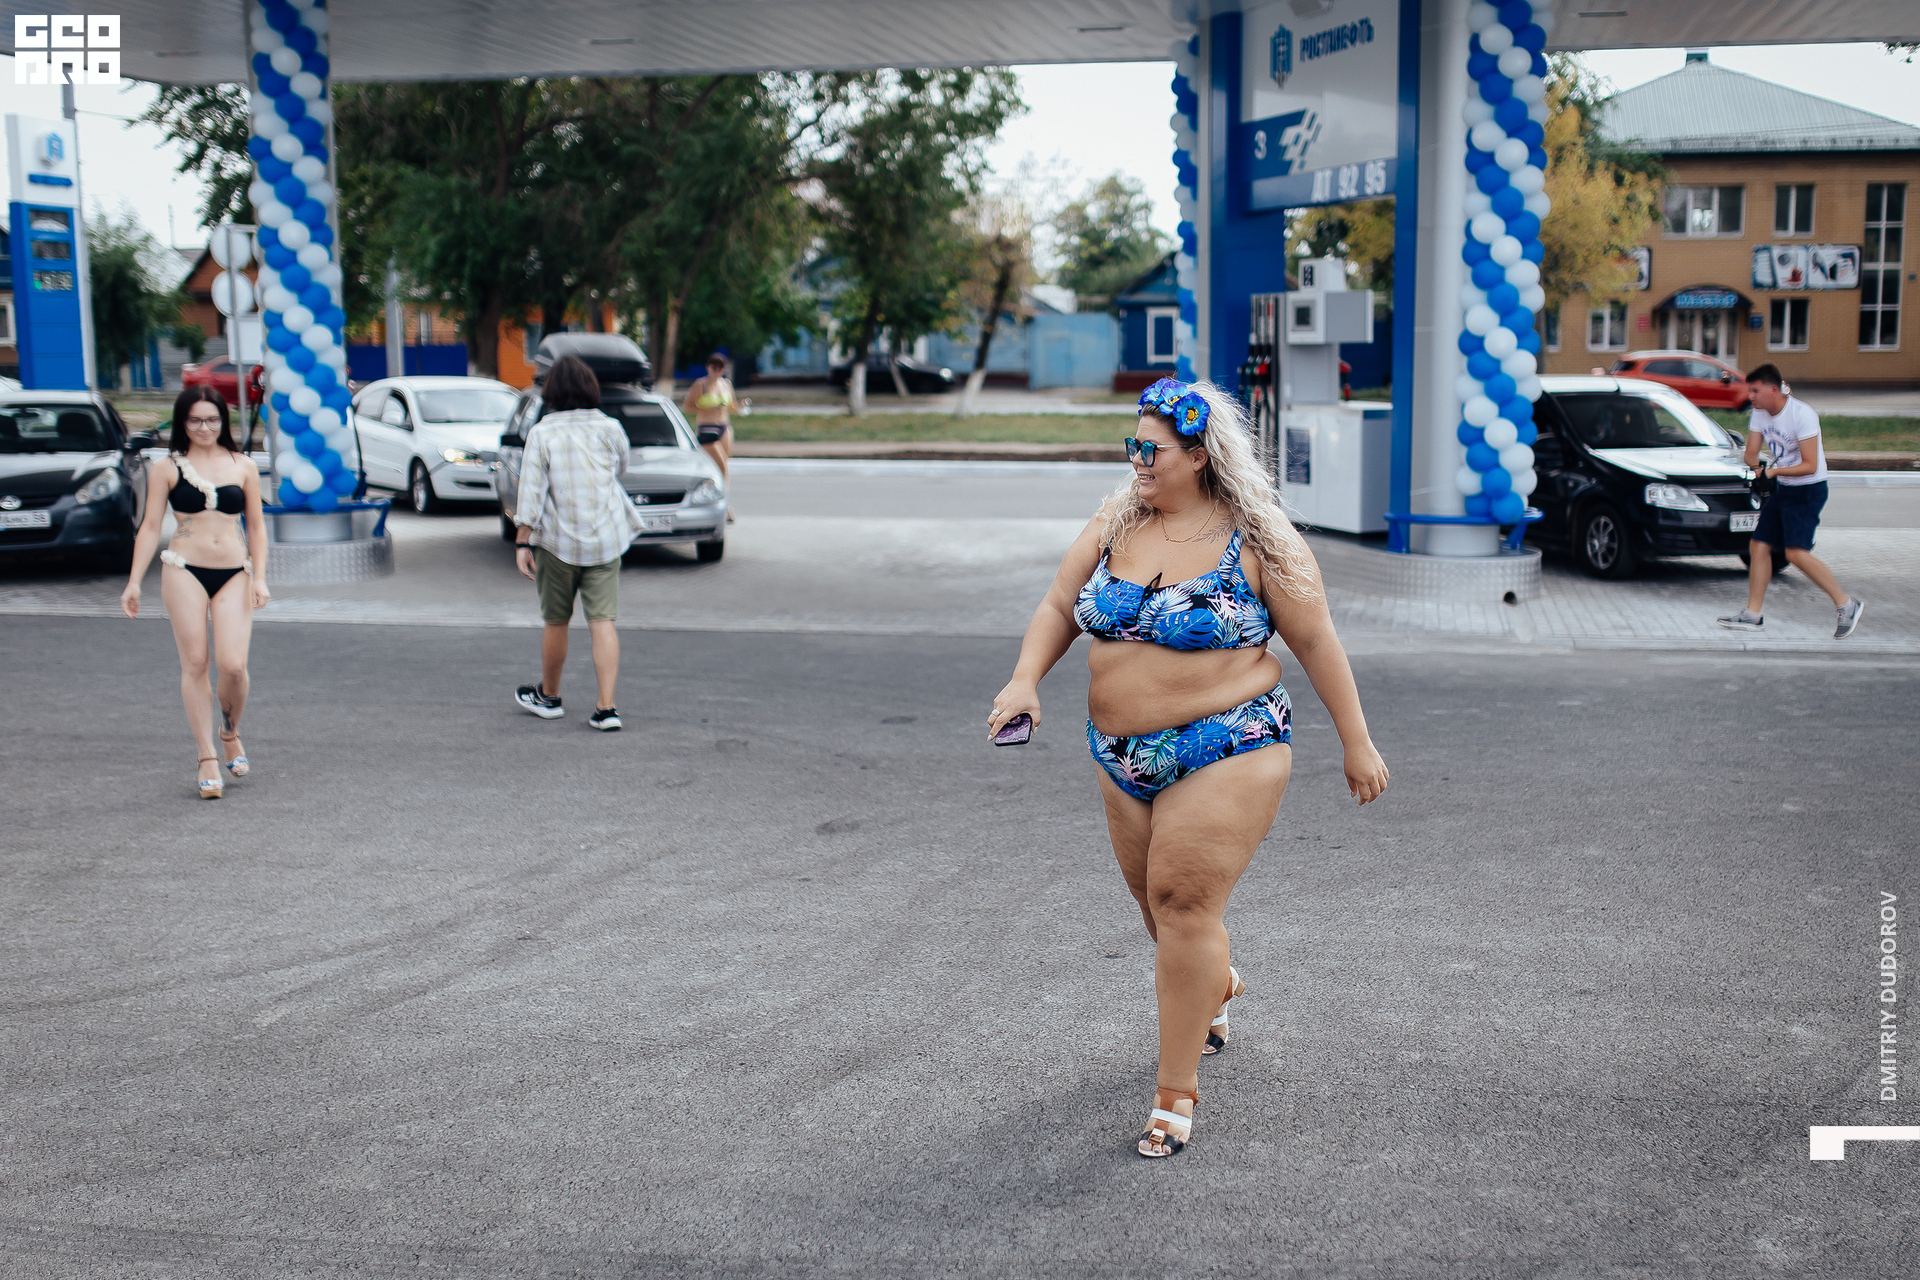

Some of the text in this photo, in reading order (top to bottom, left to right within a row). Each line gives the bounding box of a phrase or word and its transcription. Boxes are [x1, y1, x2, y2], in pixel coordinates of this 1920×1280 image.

[1255, 130, 1267, 160] 3
[1311, 160, 1386, 203] ДТ 92 95
